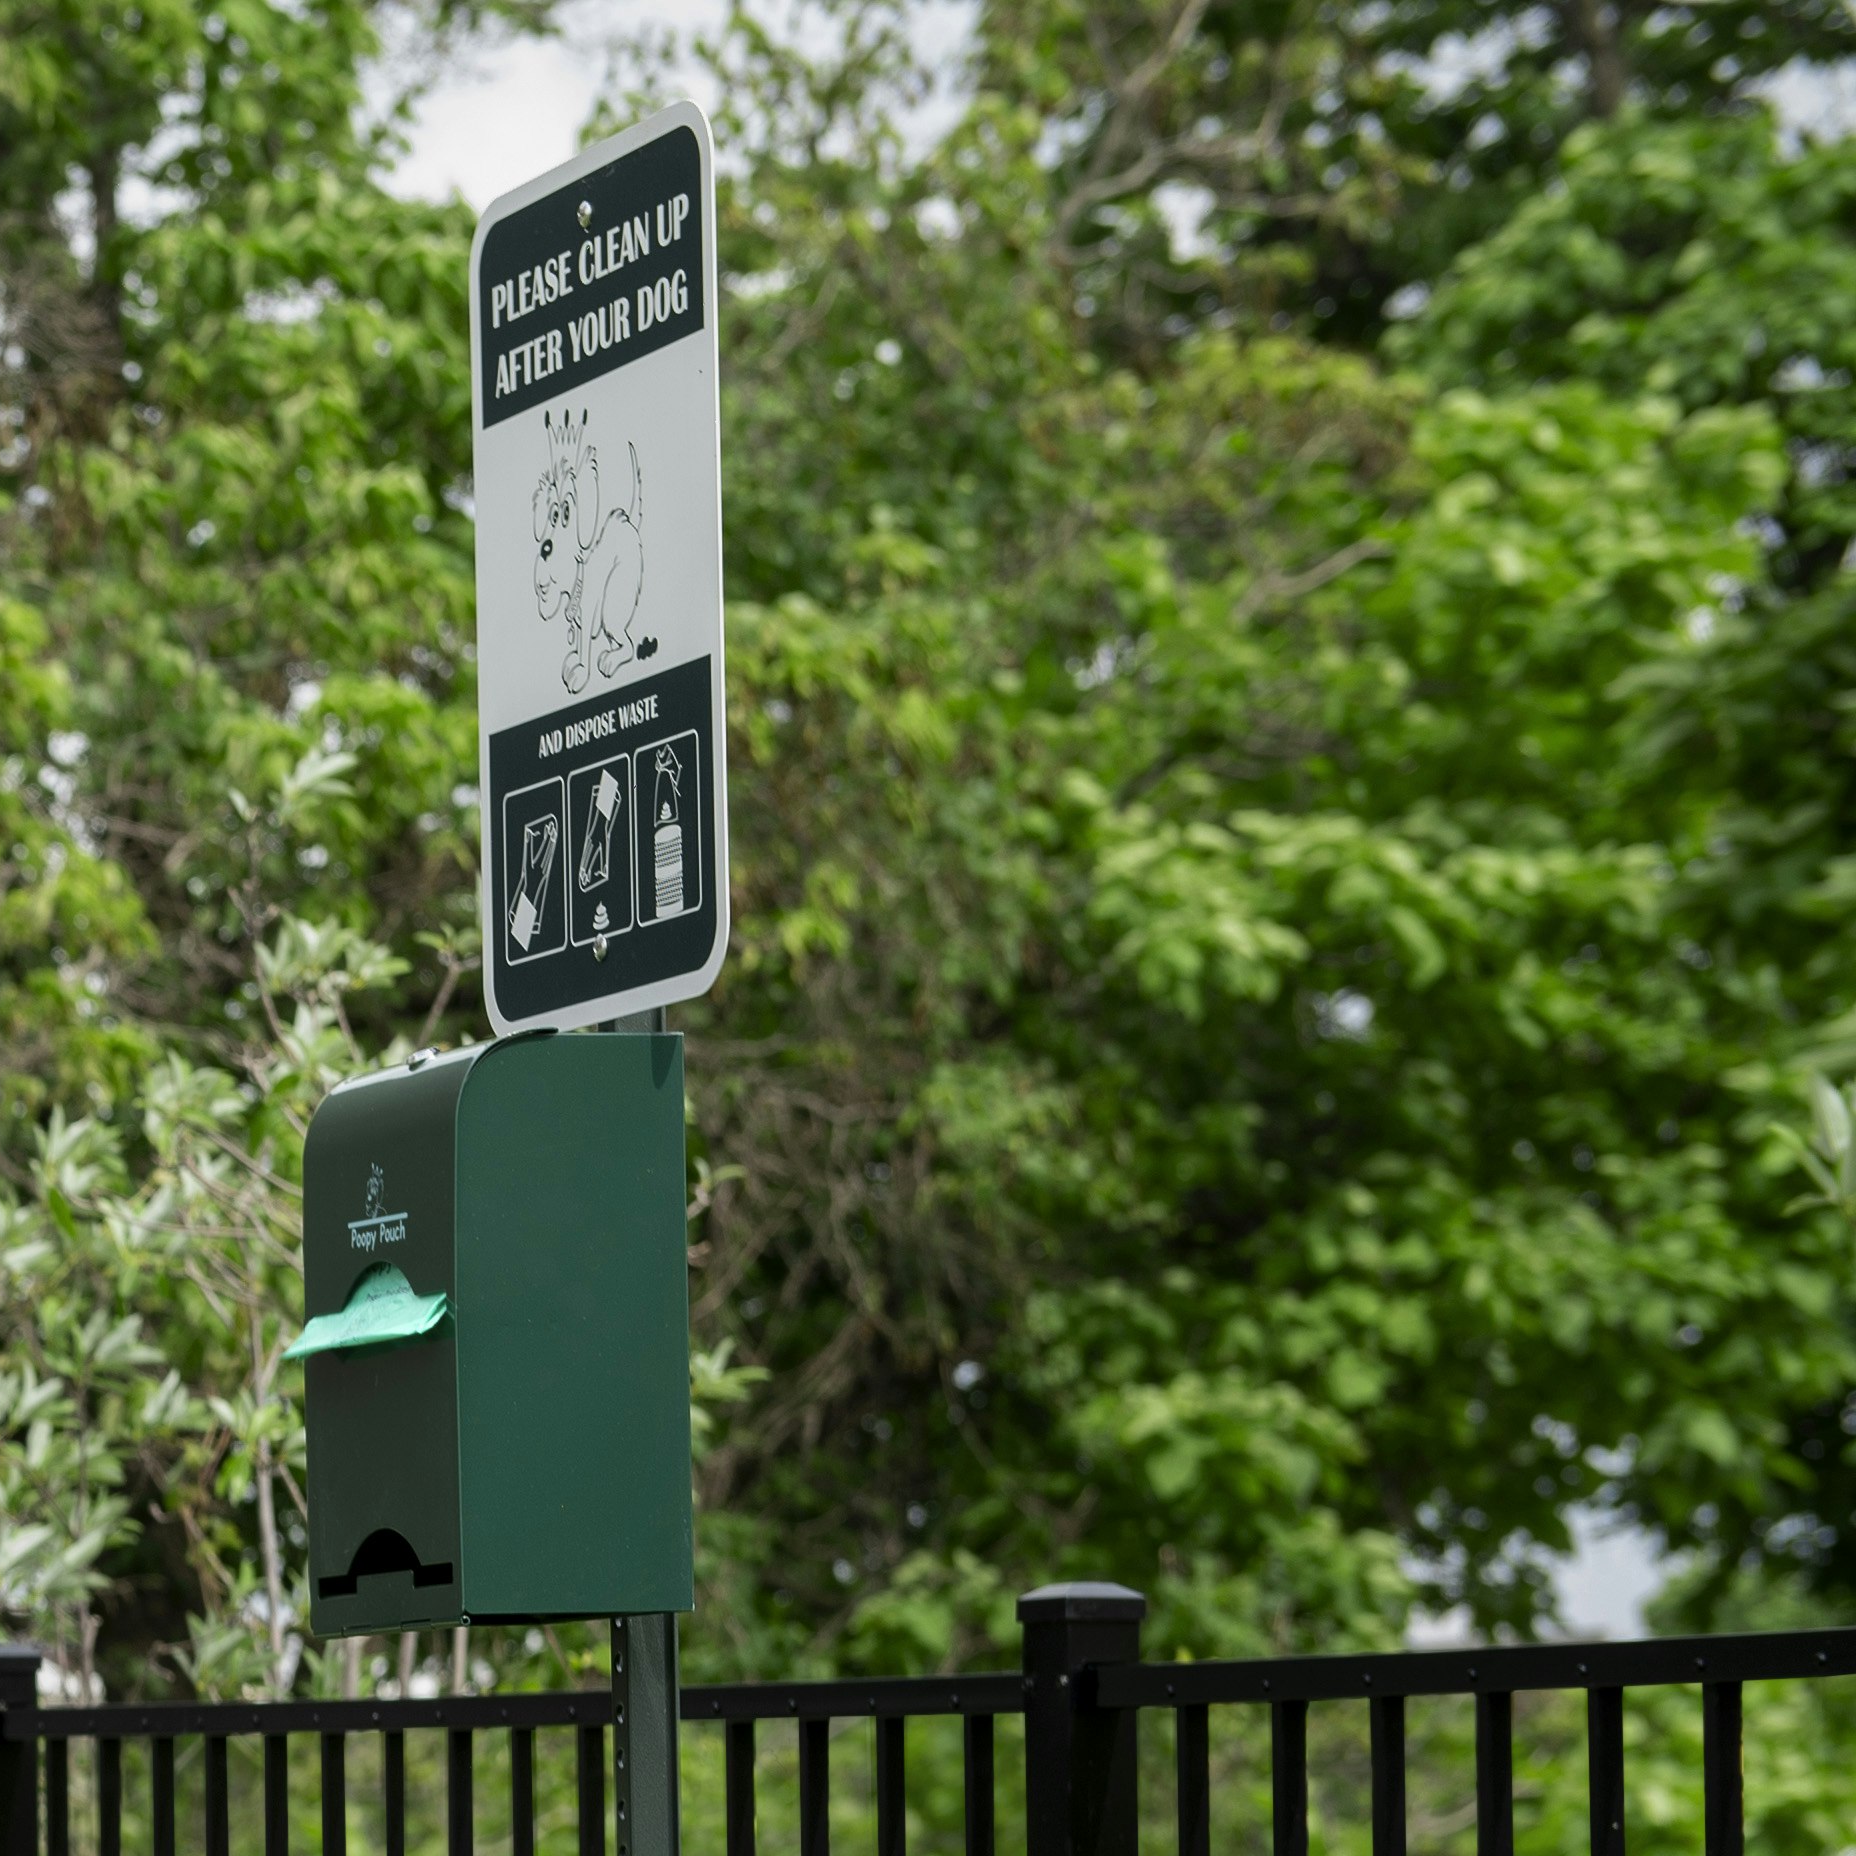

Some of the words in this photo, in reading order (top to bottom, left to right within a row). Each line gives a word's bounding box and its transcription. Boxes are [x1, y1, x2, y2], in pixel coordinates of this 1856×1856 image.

[491, 250, 574, 329] PLEASE
[578, 211, 650, 286] CLEAN
[656, 193, 689, 247] UP
[495, 328, 563, 399] AFTER
[568, 297, 631, 363] YOUR
[637, 268, 688, 332] DOG
[538, 729, 563, 759] AND
[565, 709, 617, 750] DISPOSE
[618, 694, 659, 730] WASTE
[351, 1228, 377, 1252] Poopy
[379, 1219, 406, 1243] Pouch
